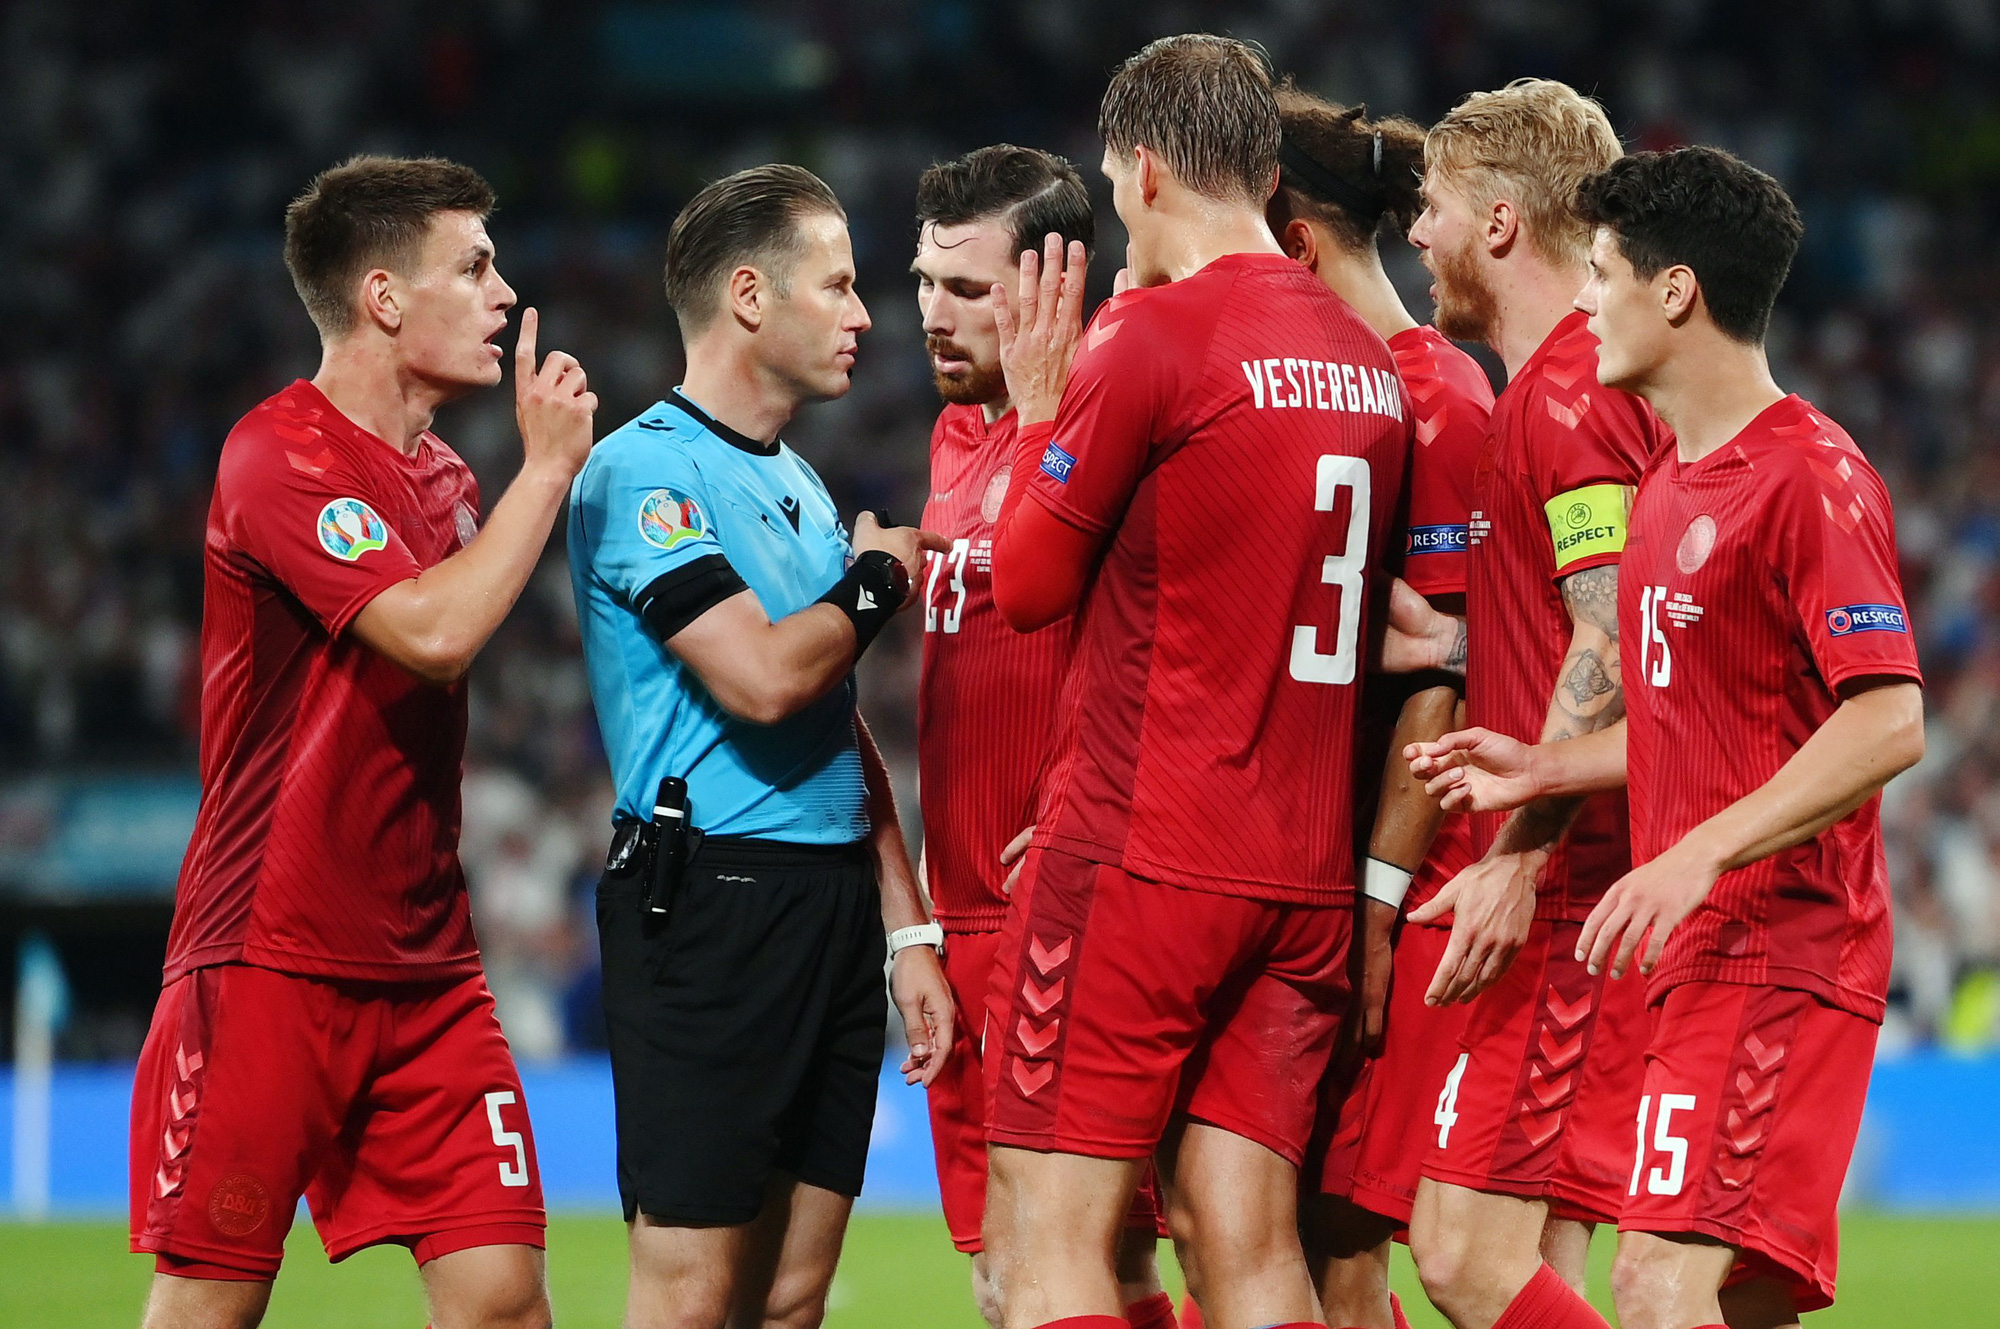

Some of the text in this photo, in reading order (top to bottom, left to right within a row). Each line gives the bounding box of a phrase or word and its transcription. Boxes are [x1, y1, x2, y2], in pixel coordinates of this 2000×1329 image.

[1241, 357, 1403, 424] VESTERGAARD
[925, 538, 970, 633] 23
[1289, 454, 1371, 685] 3
[1413, 531, 1468, 547] RESPEC
[1557, 526, 1615, 553] RESPECT
[1639, 585, 1672, 688] 15
[1852, 611, 1903, 626] RESPECT
[484, 1090, 529, 1187] 5
[1433, 1052, 1470, 1149] 4
[1628, 1093, 1697, 1196] 15
